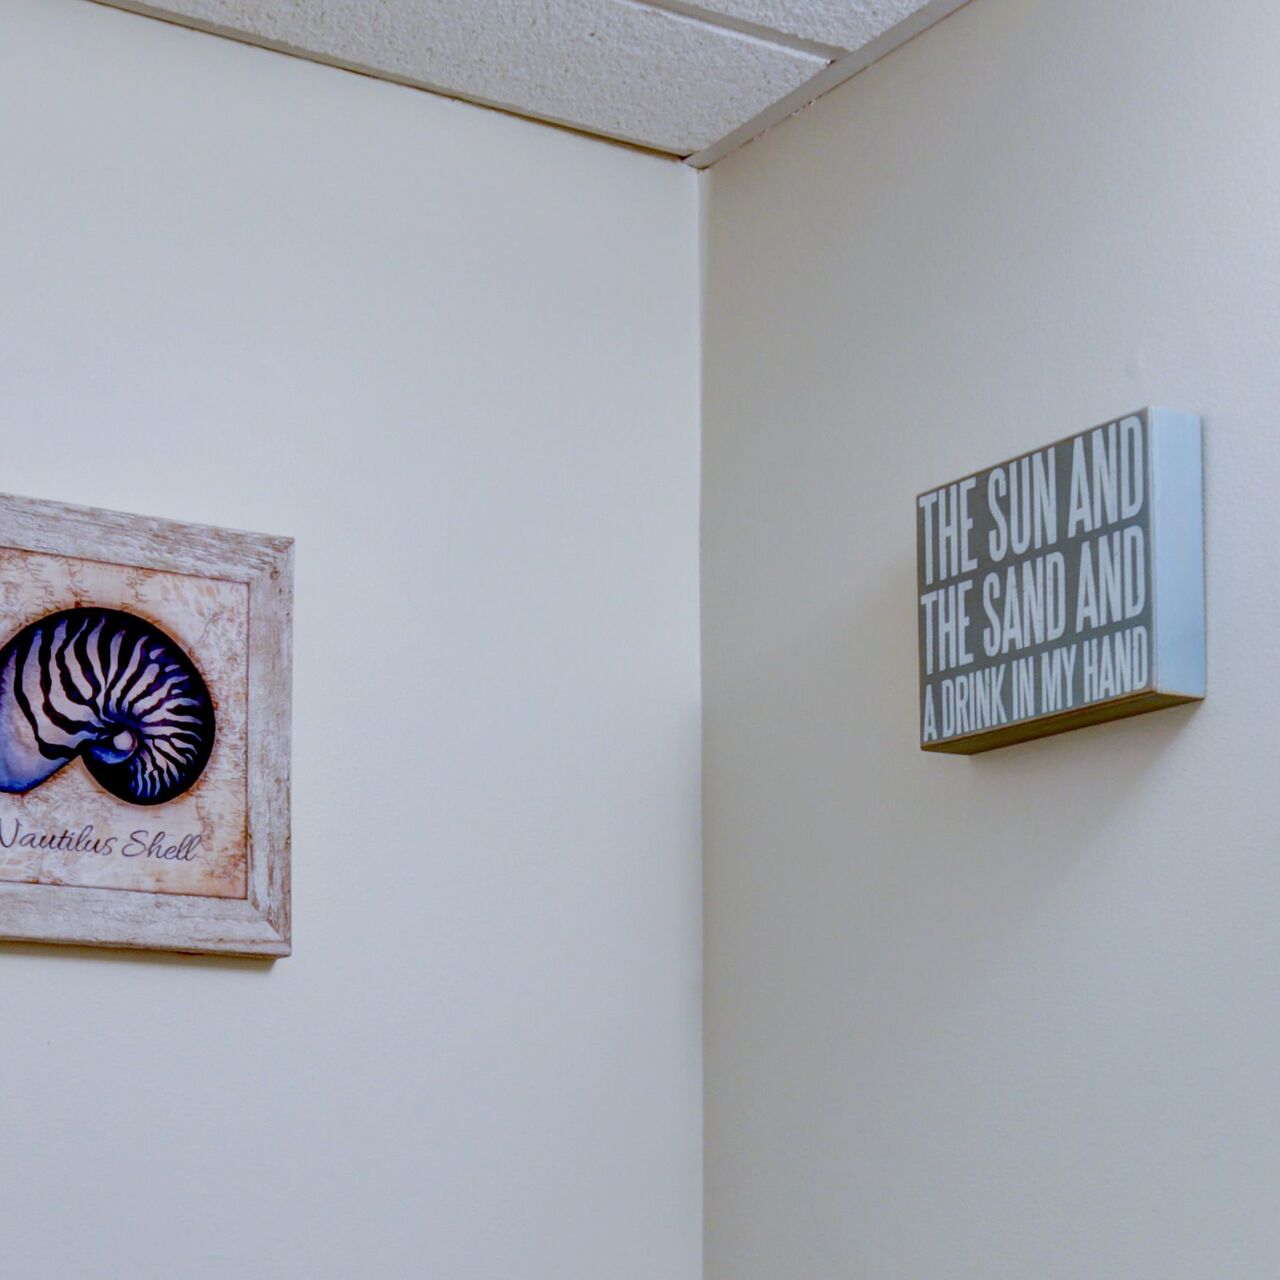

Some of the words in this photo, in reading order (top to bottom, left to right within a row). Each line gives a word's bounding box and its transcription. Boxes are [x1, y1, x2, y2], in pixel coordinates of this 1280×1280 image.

[919, 477, 978, 586] THE
[987, 446, 1058, 563] SUN
[1067, 415, 1144, 539] AND
[920, 579, 974, 676] THE
[982, 551, 1066, 658] SAND
[1075, 524, 1146, 634] AND
[923, 683, 937, 743] A
[941, 662, 1008, 739] DRINK
[1012, 655, 1035, 721] IN
[1041, 643, 1078, 714] MY
[1083, 625, 1149, 704] HAND
[121, 829, 202, 862] Shell
